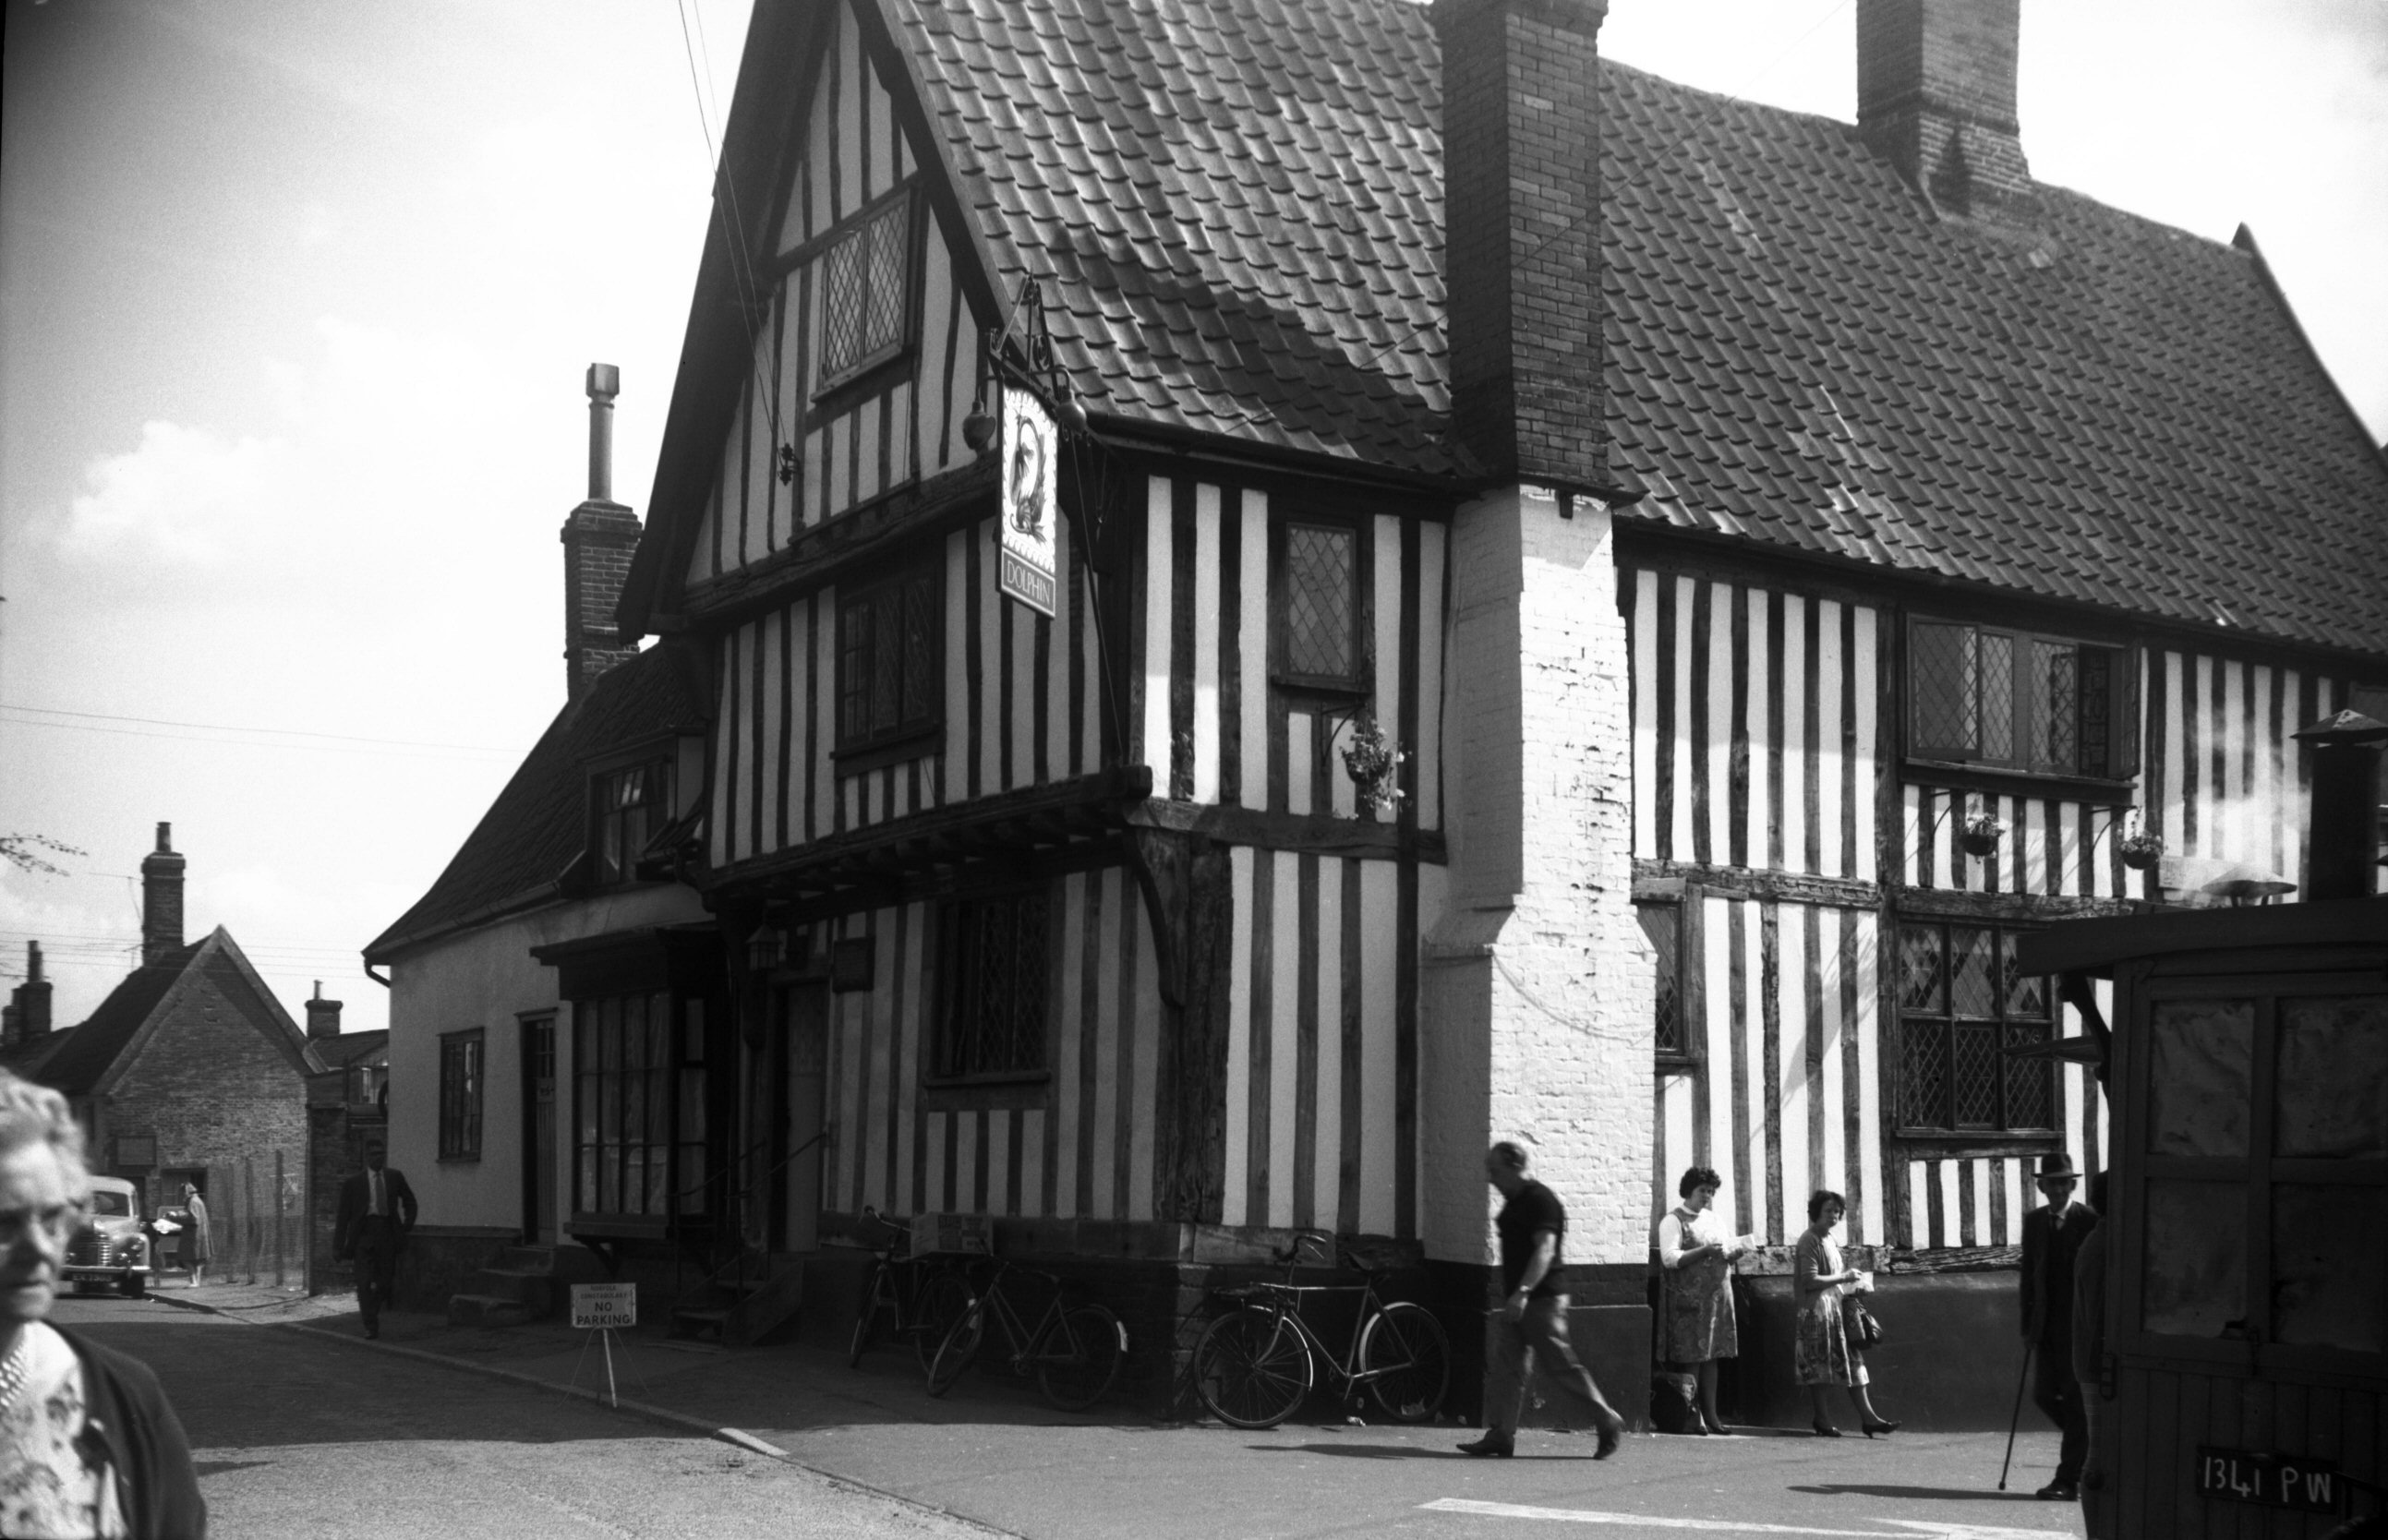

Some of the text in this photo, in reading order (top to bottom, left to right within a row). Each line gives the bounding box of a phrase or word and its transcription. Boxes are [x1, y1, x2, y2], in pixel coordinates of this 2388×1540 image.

[1007, 559, 1051, 606] DOLPHIN
[576, 1314, 630, 1325] PARKING
[594, 1302, 613, 1312] NO
[2203, 1455, 2261, 1498] 1341
